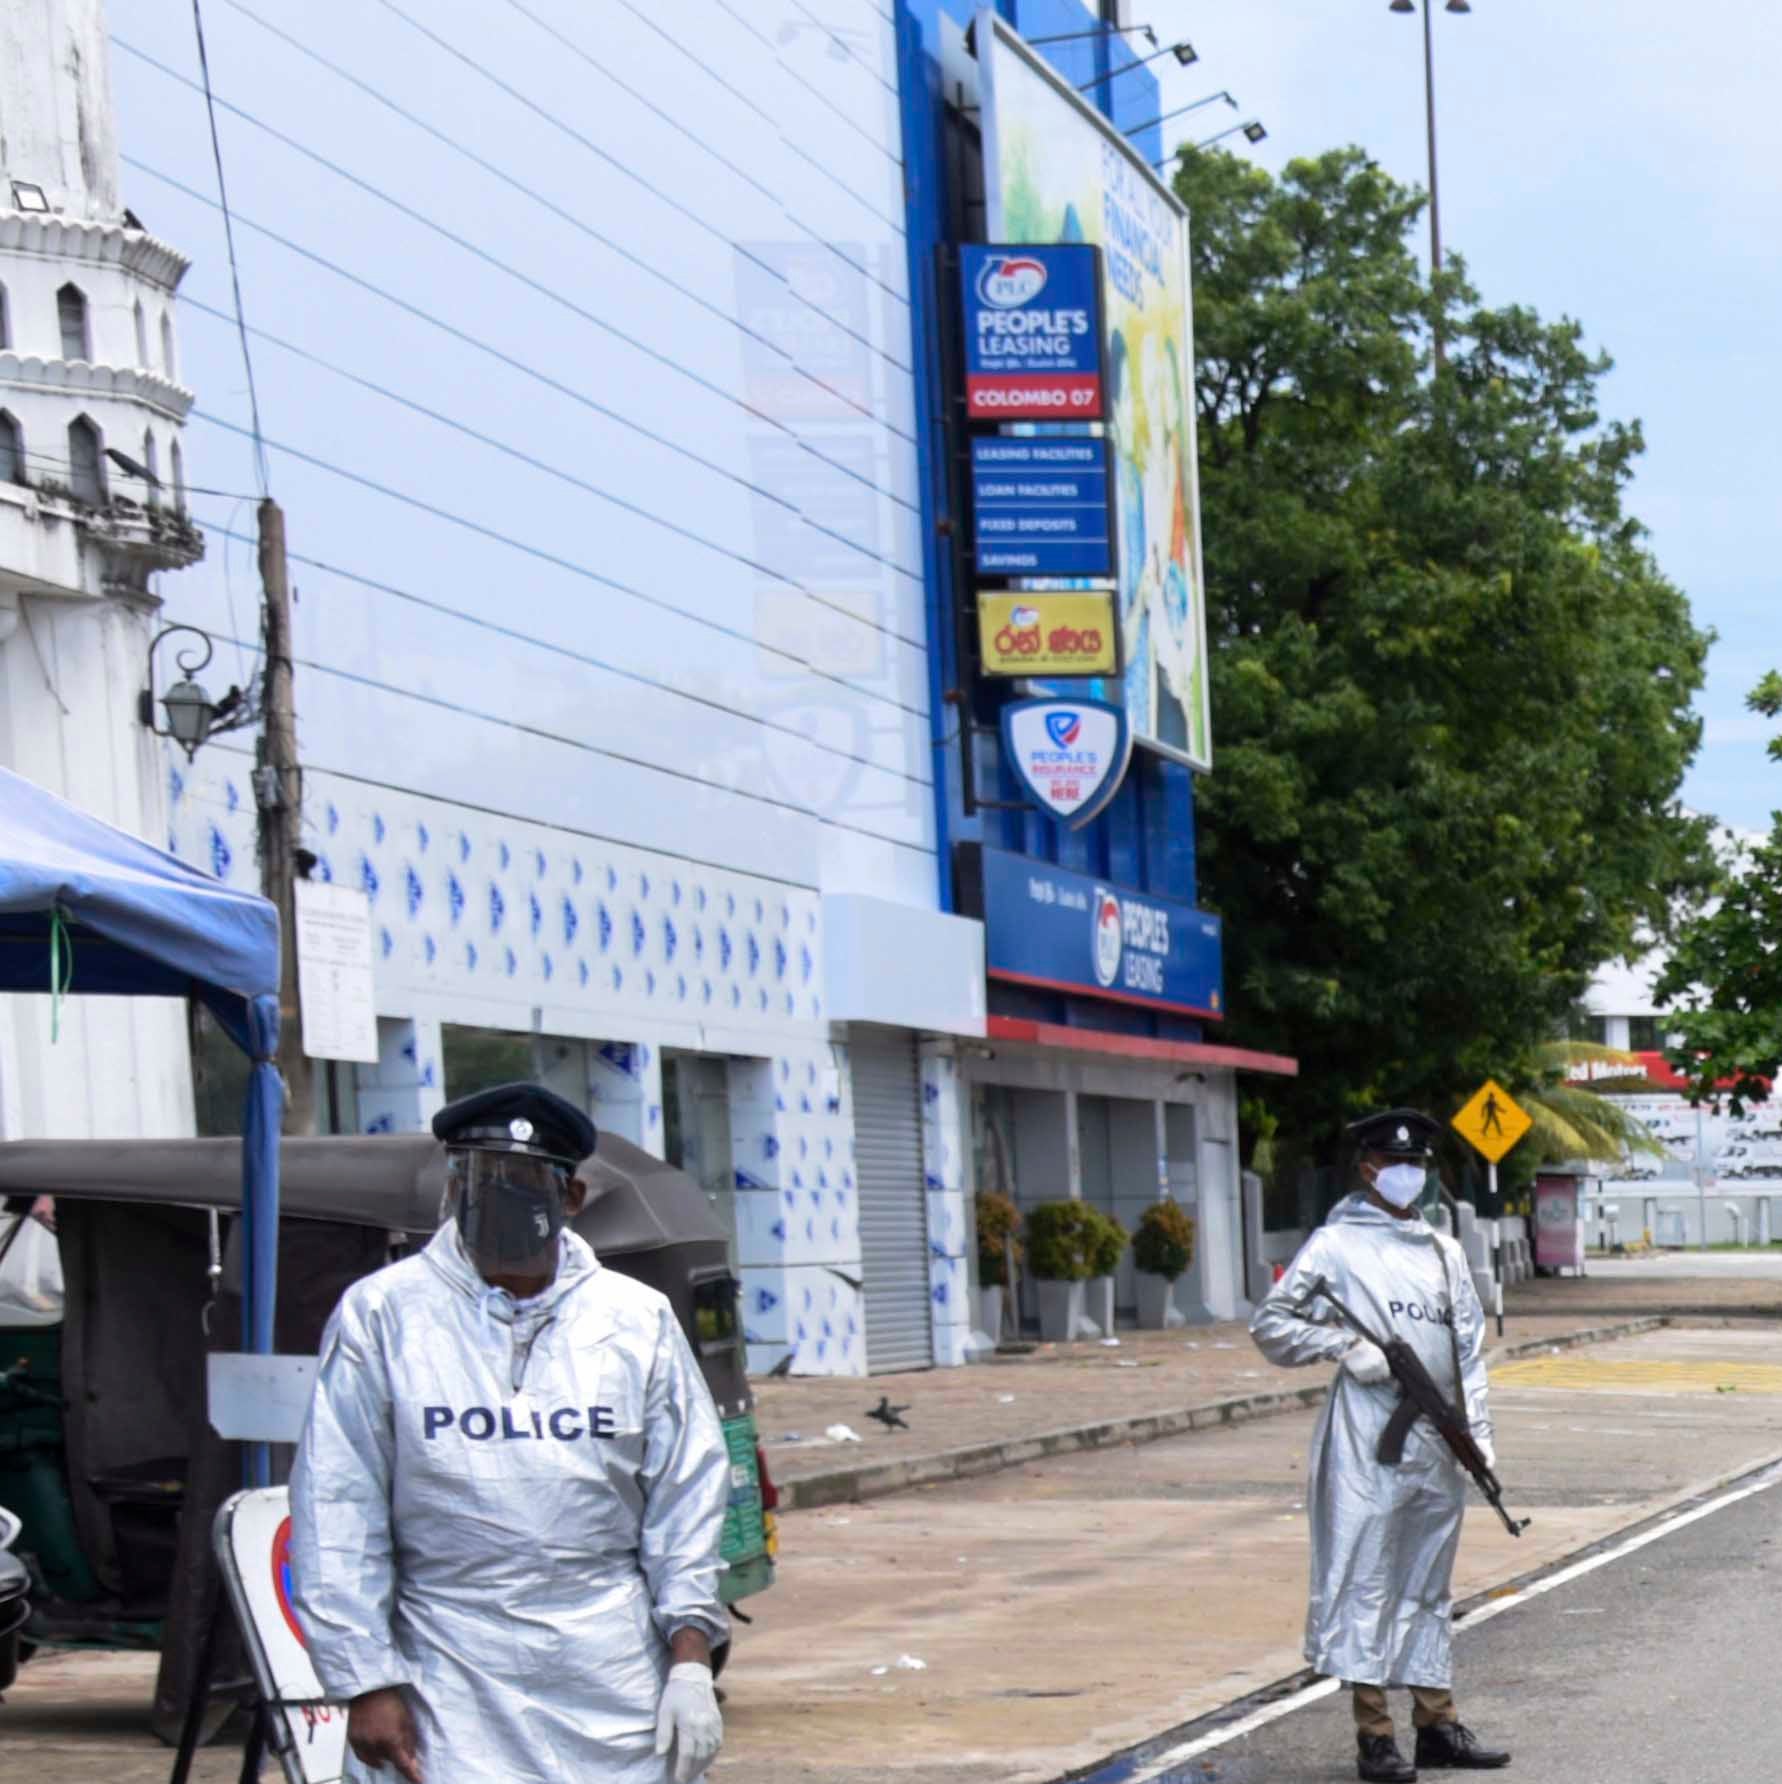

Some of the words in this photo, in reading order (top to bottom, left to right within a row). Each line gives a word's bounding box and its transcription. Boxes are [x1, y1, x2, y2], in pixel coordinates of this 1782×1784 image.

[977, 311, 1088, 335] PEOPLE'S
[979, 336, 1070, 356] LEASING
[974, 390, 1067, 406] COLOMBO
[1070, 390, 1095, 406] 07
[977, 448, 1030, 460] LEASING
[423, 1406, 616, 1441] POLICE
